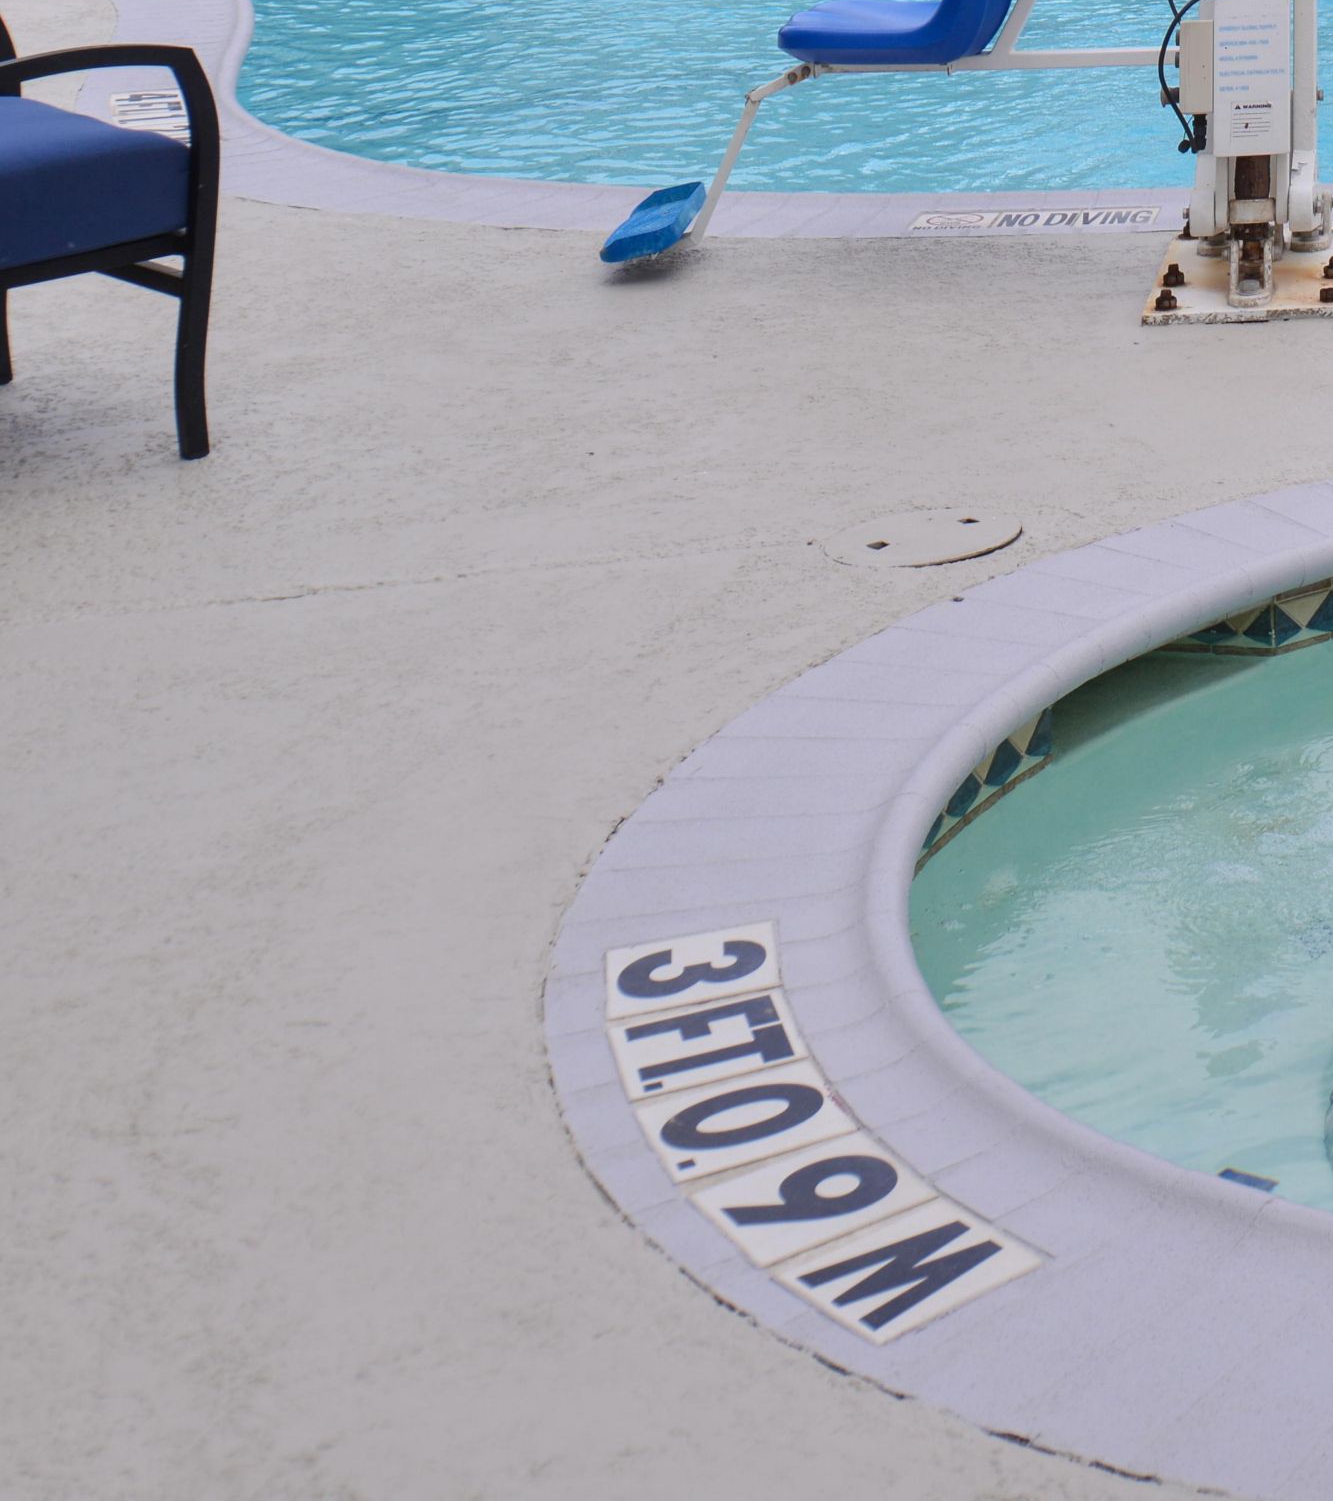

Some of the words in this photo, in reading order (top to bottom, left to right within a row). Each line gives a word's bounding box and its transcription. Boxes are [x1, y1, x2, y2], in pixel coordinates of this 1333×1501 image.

[998, 213, 1041, 227] NO
[1043, 210, 1153, 226] DIVING
[617, 939, 767, 999] 3
[797, 1220, 1004, 1332] M
